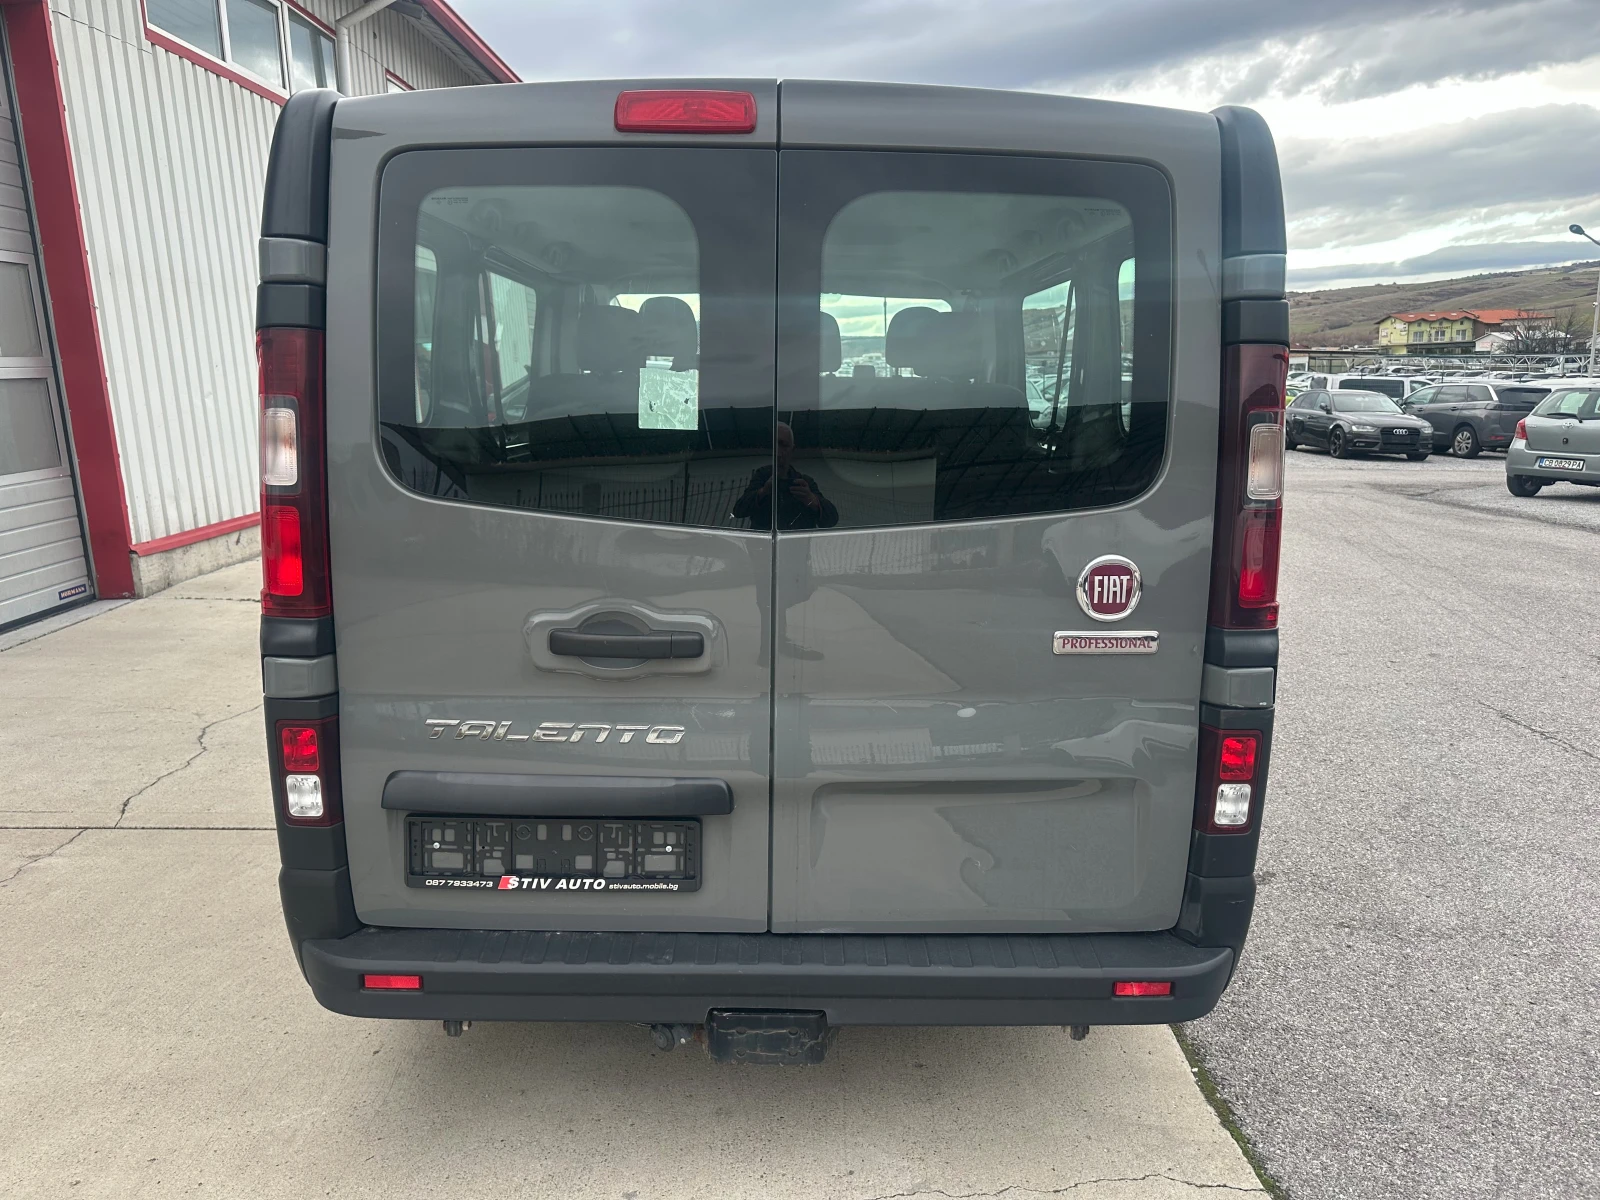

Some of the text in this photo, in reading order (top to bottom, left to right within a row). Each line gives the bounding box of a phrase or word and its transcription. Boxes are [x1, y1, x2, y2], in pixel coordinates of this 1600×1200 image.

[1093, 575, 1130, 604] FIAT
[1062, 637, 1153, 649] PROFESSIONAL
[425, 718, 686, 745] TALENTO
[425, 879, 445, 887] 087
[507, 877, 552, 890] STIV
[555, 878, 606, 890] AUTO
[608, 883, 679, 891] stivauto.mobile.bg
